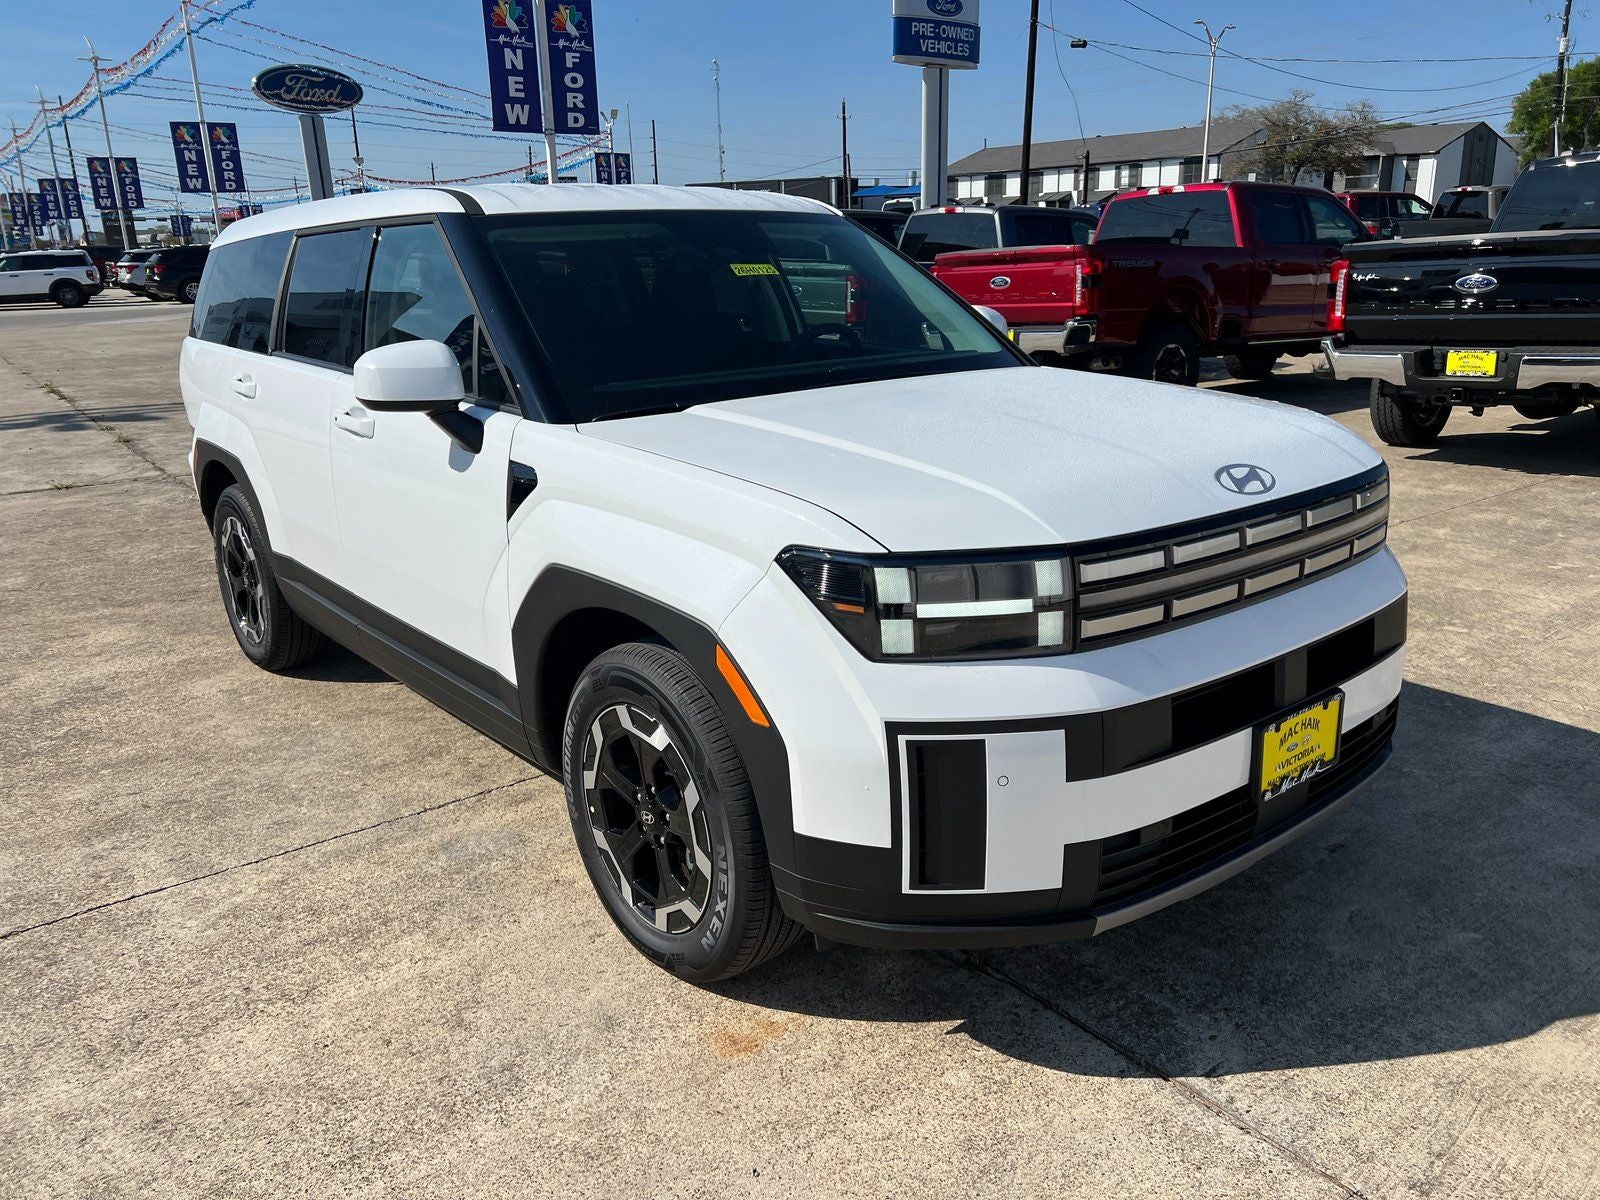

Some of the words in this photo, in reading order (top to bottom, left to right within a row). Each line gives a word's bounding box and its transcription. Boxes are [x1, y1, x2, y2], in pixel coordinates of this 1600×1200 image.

[935, 0, 956, 12] Ford
[911, 22, 975, 41] PRE-OWNED
[920, 39, 970, 56] VEHICLES
[281, 74, 342, 102] Ford
[503, 48, 530, 125] NEW
[564, 52, 586, 128] FORD
[183, 150, 202, 189] NEW
[221, 150, 237, 190] FORD
[46, 194, 58, 217] NEW
[68, 194, 79, 218] FORD
[96, 177, 112, 207] NEW
[125, 177, 137, 207] FORD
[1112, 259, 1156, 268] TREMOR
[1278, 721, 1300, 751] MAC
[1300, 717, 1321, 732] HAIK
[1281, 745, 1316, 770] VICTORIA
[701, 844, 728, 953] NEXEN
